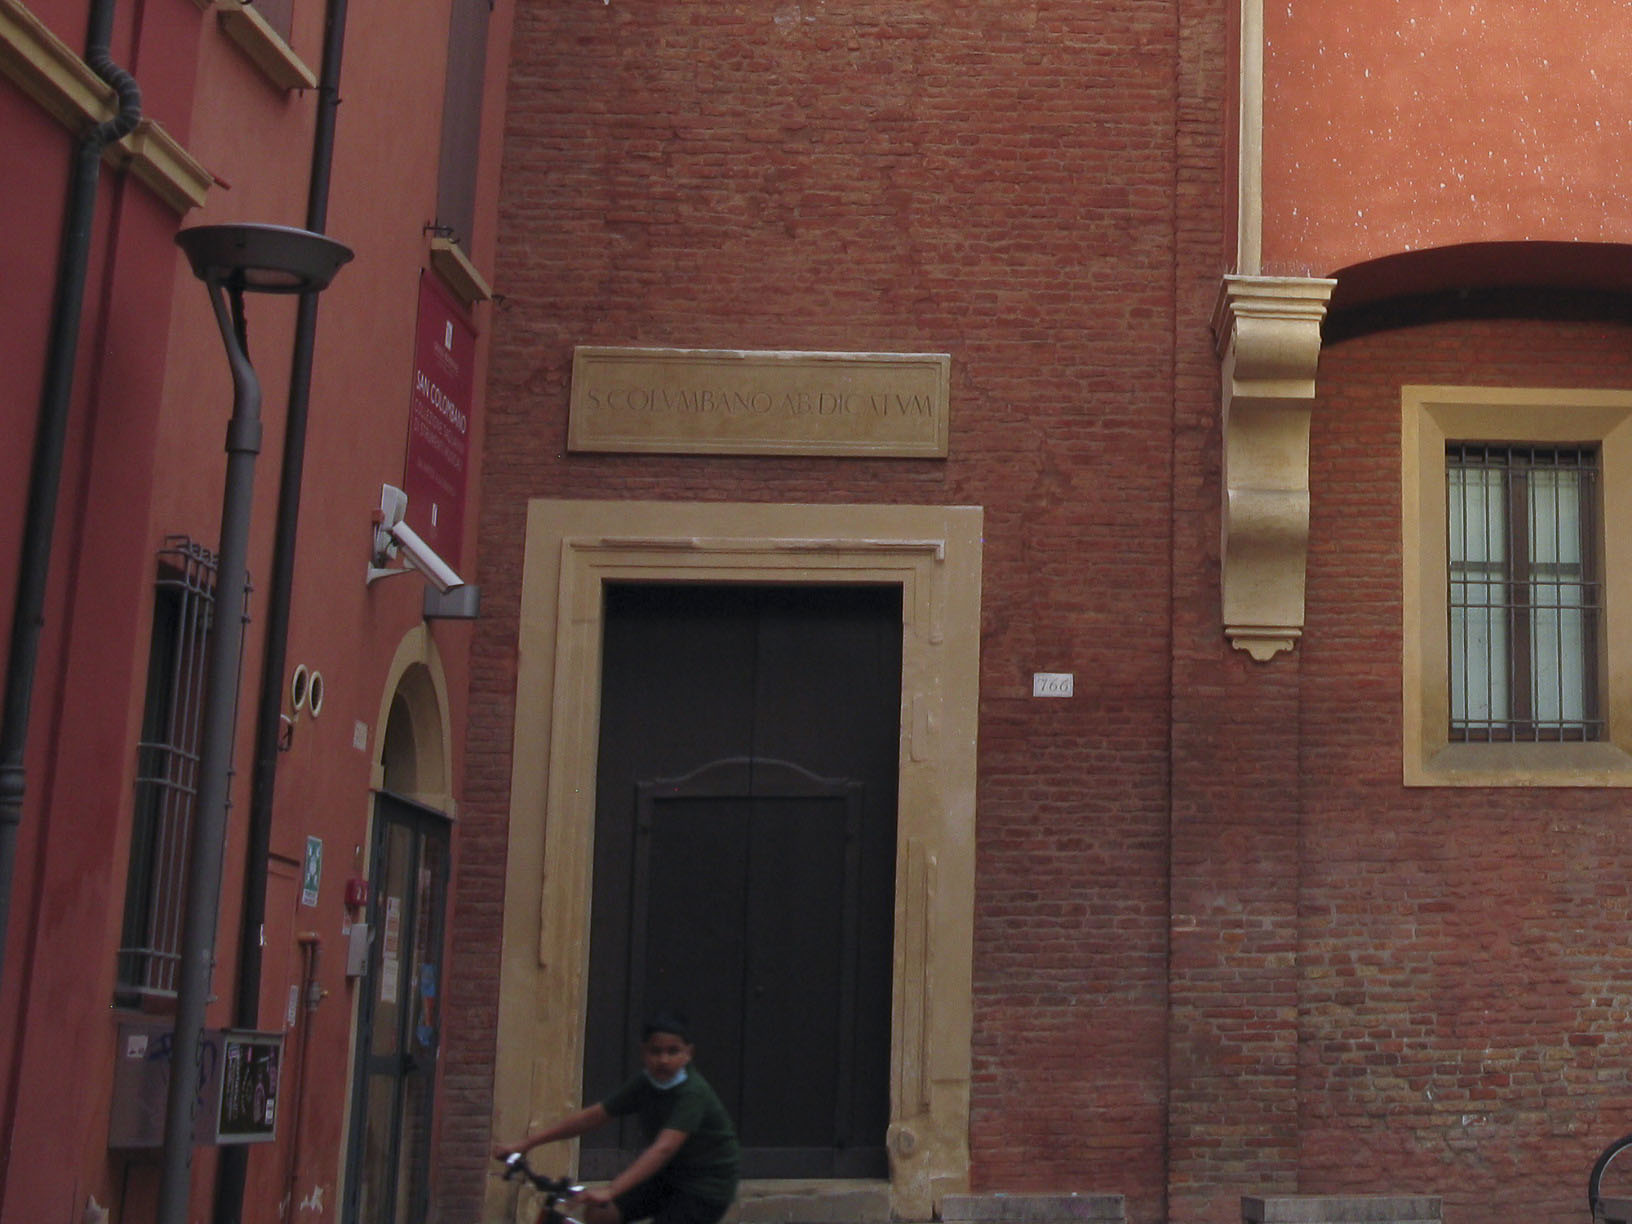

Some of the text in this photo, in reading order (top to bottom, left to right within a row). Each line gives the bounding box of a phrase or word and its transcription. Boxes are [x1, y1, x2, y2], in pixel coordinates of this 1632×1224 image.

[416, 370, 430, 397] SAN
[430, 383, 467, 434] COLOMBANO
[1038, 678, 1069, 692] 766
